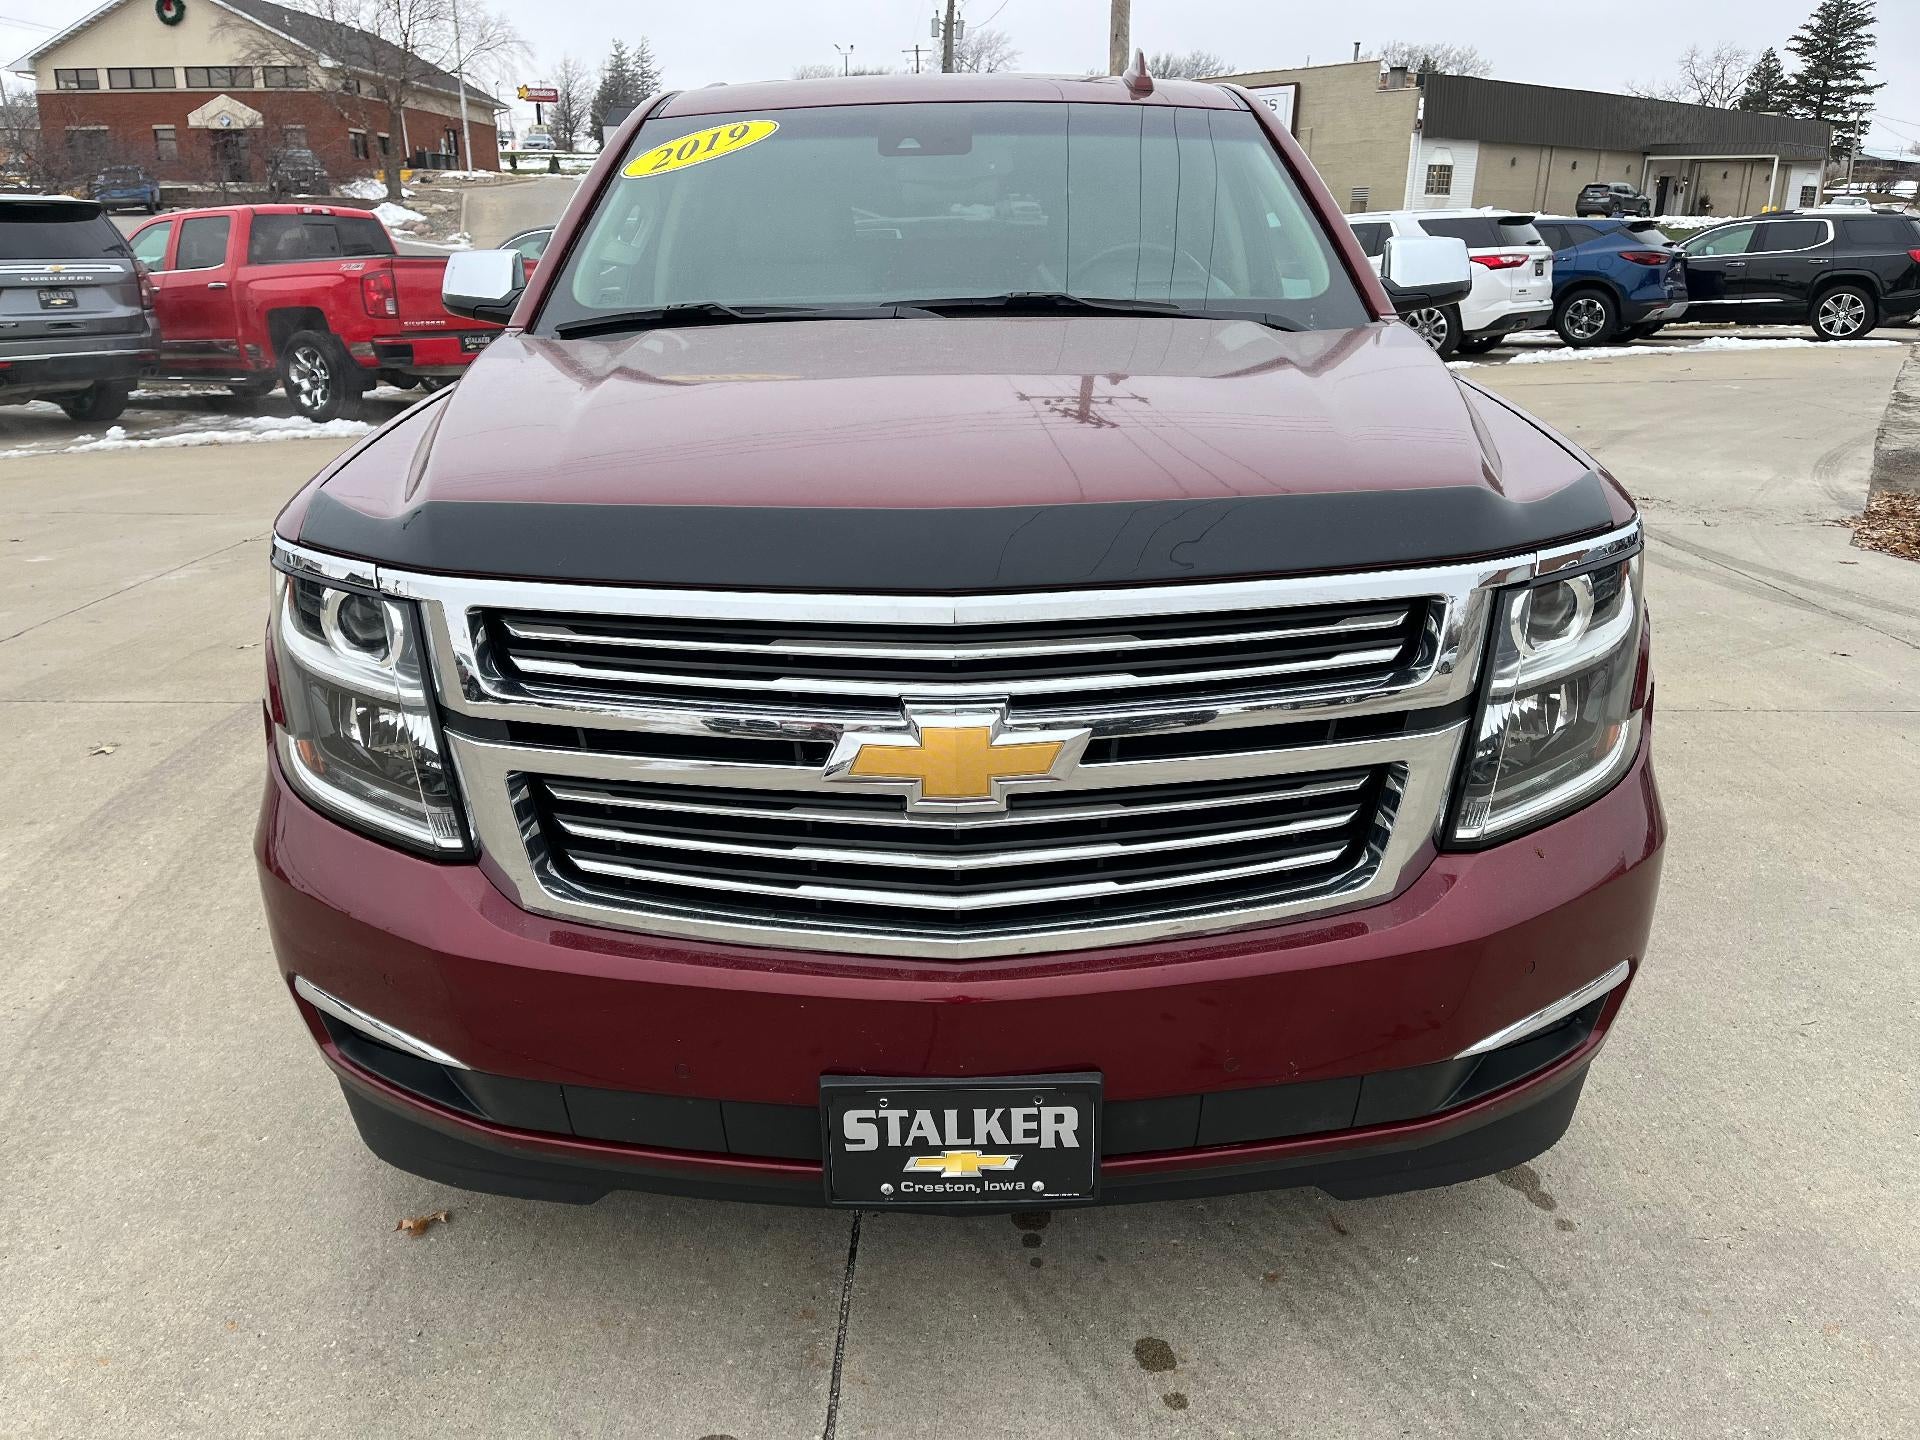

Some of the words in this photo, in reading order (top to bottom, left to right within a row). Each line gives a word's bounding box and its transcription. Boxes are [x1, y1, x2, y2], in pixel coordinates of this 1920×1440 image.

[649, 124, 751, 172] 2019
[39, 291, 74, 300] STALKER
[843, 1106, 1080, 1152] STALKER
[900, 1181, 981, 1193] Creston,
[984, 1180, 1026, 1192] Iowa
